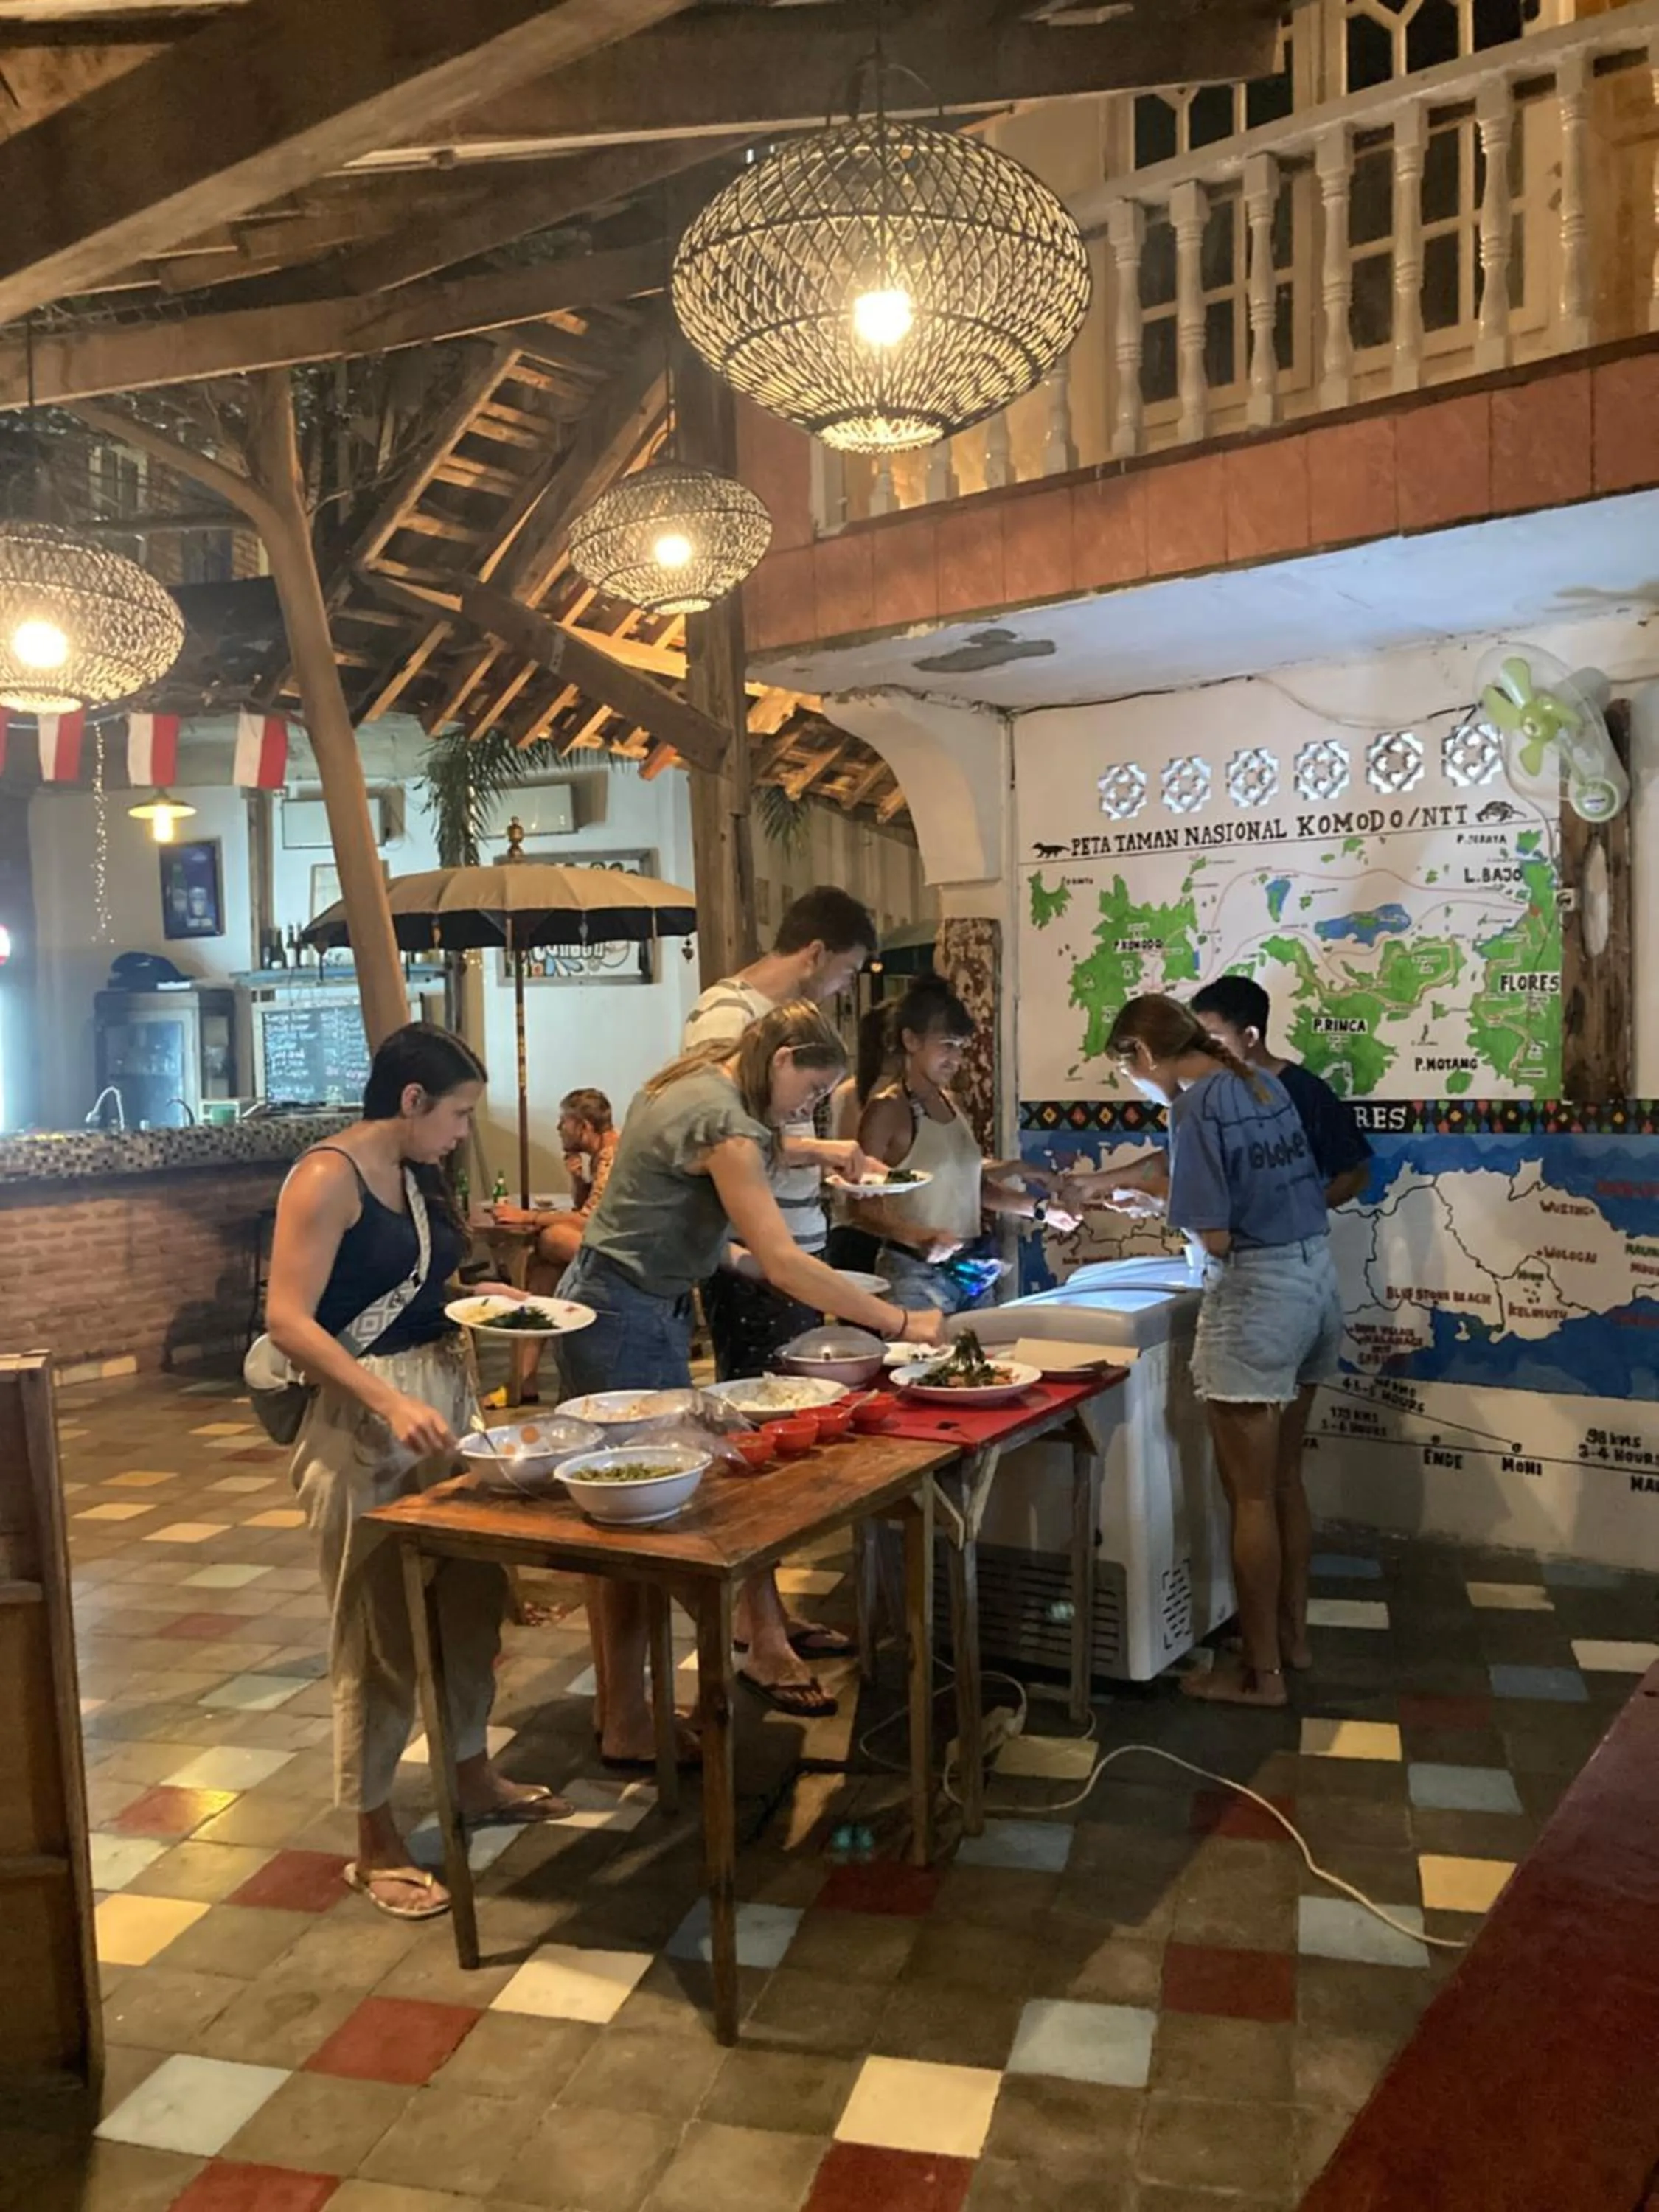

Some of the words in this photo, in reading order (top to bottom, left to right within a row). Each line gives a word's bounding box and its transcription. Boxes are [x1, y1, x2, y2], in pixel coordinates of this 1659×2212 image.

[1071, 836, 1110, 857] PETA
[1114, 830, 1178, 852] TAMAN
[1185, 819, 1287, 846] NASIONAL
[1464, 867, 1523, 883] L.BAJO
[1500, 975, 1560, 992] FLORES
[1354, 1107, 1408, 1130] RES
[1424, 1448, 1464, 1470] ENDE
